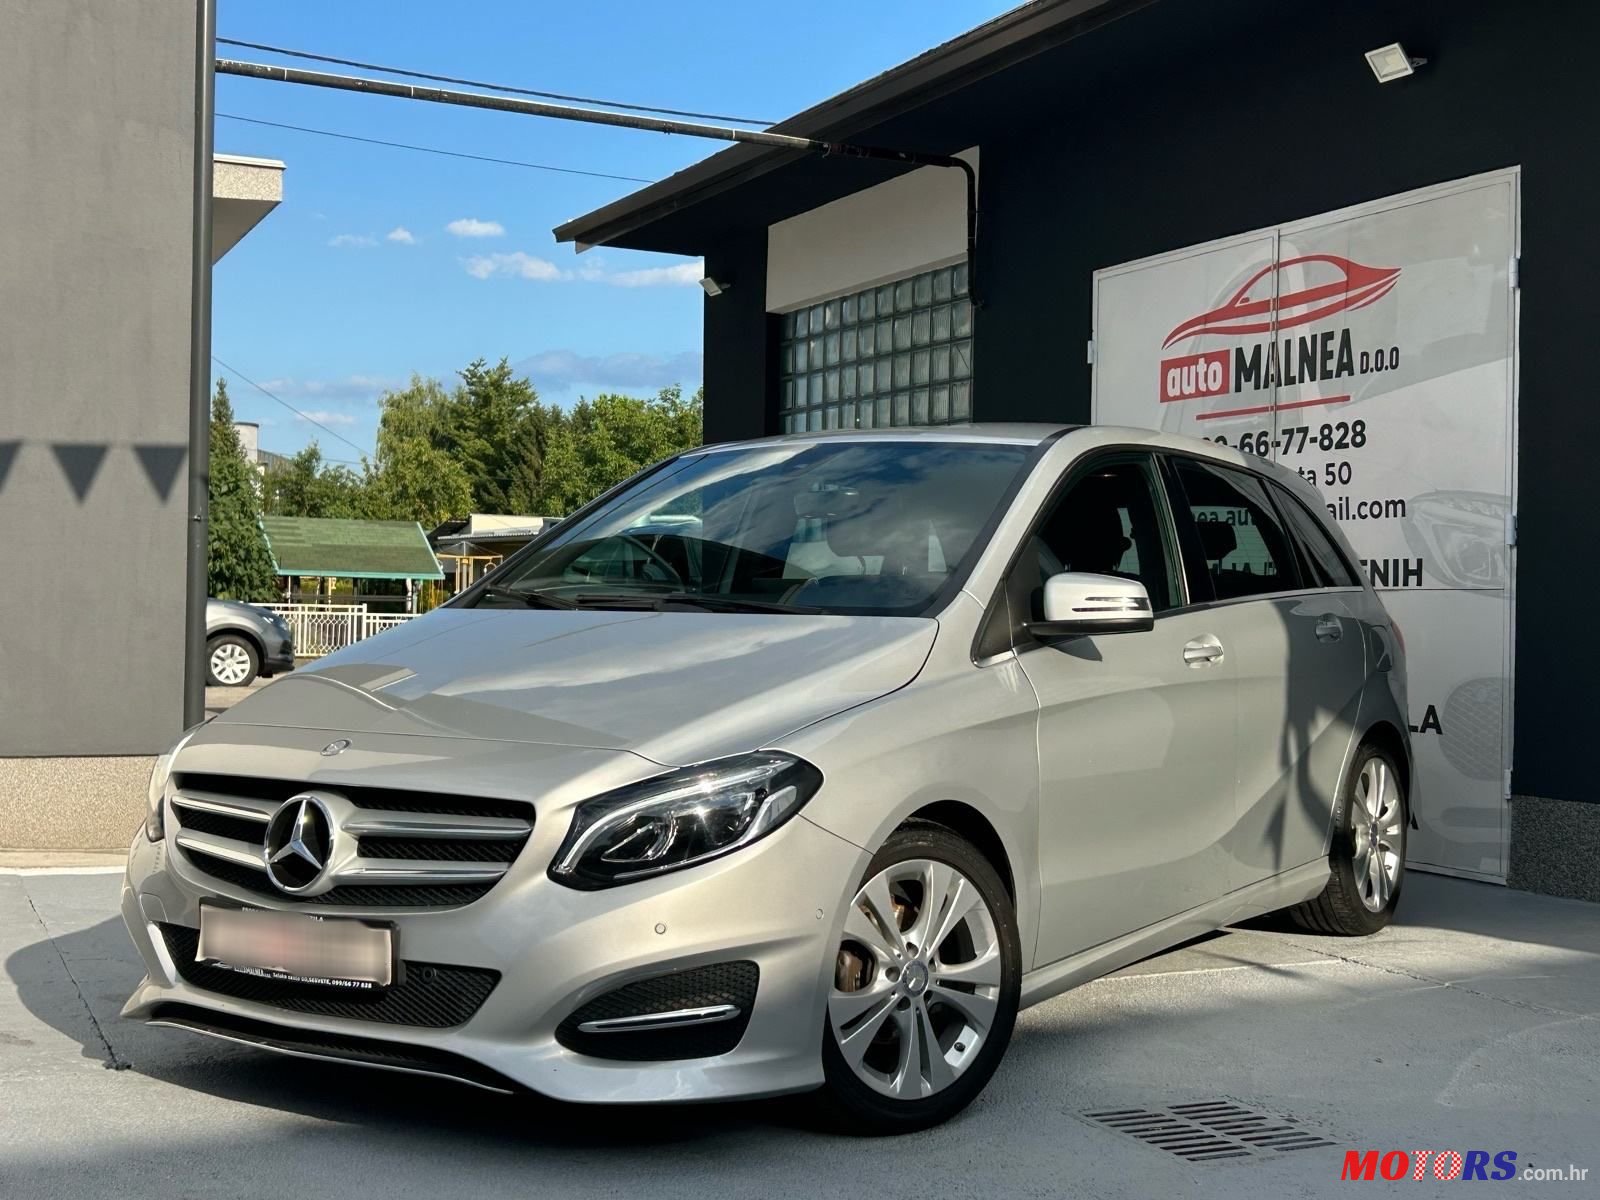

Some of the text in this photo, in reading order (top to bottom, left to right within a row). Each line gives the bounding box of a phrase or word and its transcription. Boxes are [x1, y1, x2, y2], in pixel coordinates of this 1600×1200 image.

[1167, 357, 1223, 397] auto
[1234, 328, 1355, 393] MALNEA
[1324, 461, 1352, 486] 50
[1326, 496, 1406, 521] ail.com
